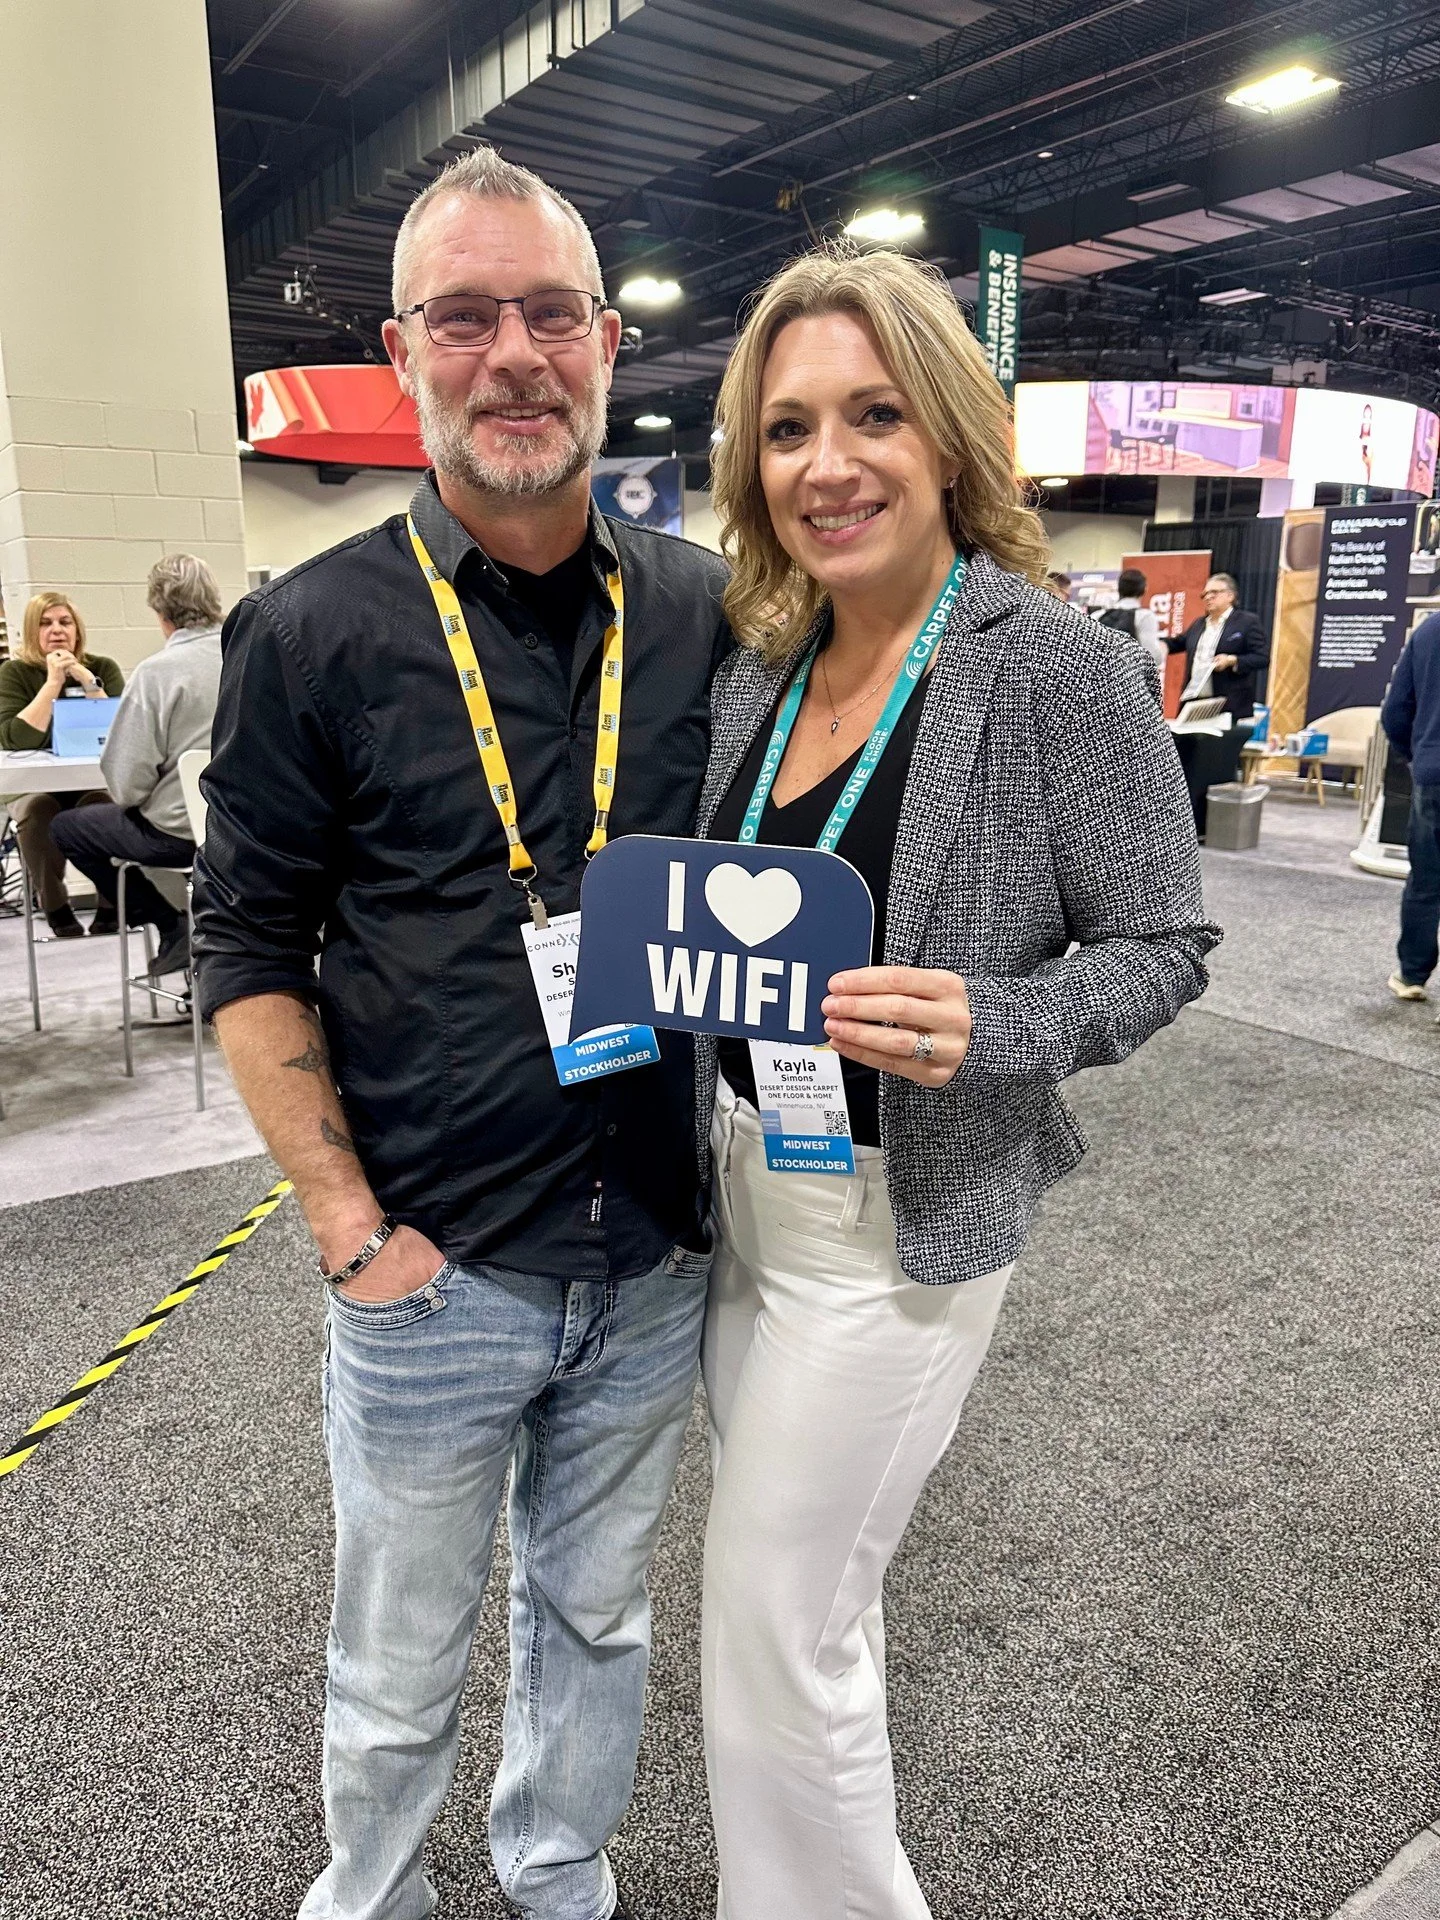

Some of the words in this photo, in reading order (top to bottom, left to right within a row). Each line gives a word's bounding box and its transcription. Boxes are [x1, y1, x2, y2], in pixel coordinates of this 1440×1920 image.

[988, 250, 1002, 267] &
[1000, 253, 1018, 381] INSURANCE
[1330, 542, 1346, 552] The
[1346, 541, 1375, 553] Beauty
[1375, 540, 1386, 551] of
[1328, 554, 1354, 565] Italian
[1327, 566, 1366, 576] Perfected
[1367, 566, 1385, 575] with
[1326, 578, 1368, 588] American
[912, 584, 960, 660] CARPET
[954, 557, 970, 583] ON
[863, 729, 882, 762] FLOOR
[748, 749, 779, 819] CARPET
[820, 815, 841, 851] PET
[841, 767, 871, 809] ONE
[667, 861, 686, 932] I
[551, 962, 576, 979] Sh
[546, 989, 575, 1002] DESER
[646, 943, 809, 1032] WIFI
[575, 1034, 631, 1057] MIDWEST
[564, 1050, 652, 1081] STOCKHOLDER
[773, 1058, 817, 1075] Kayla
[781, 1074, 814, 1082] Simons
[782, 1140, 831, 1151] MIDWEST
[772, 1158, 848, 1171] STOCKHOLDER
